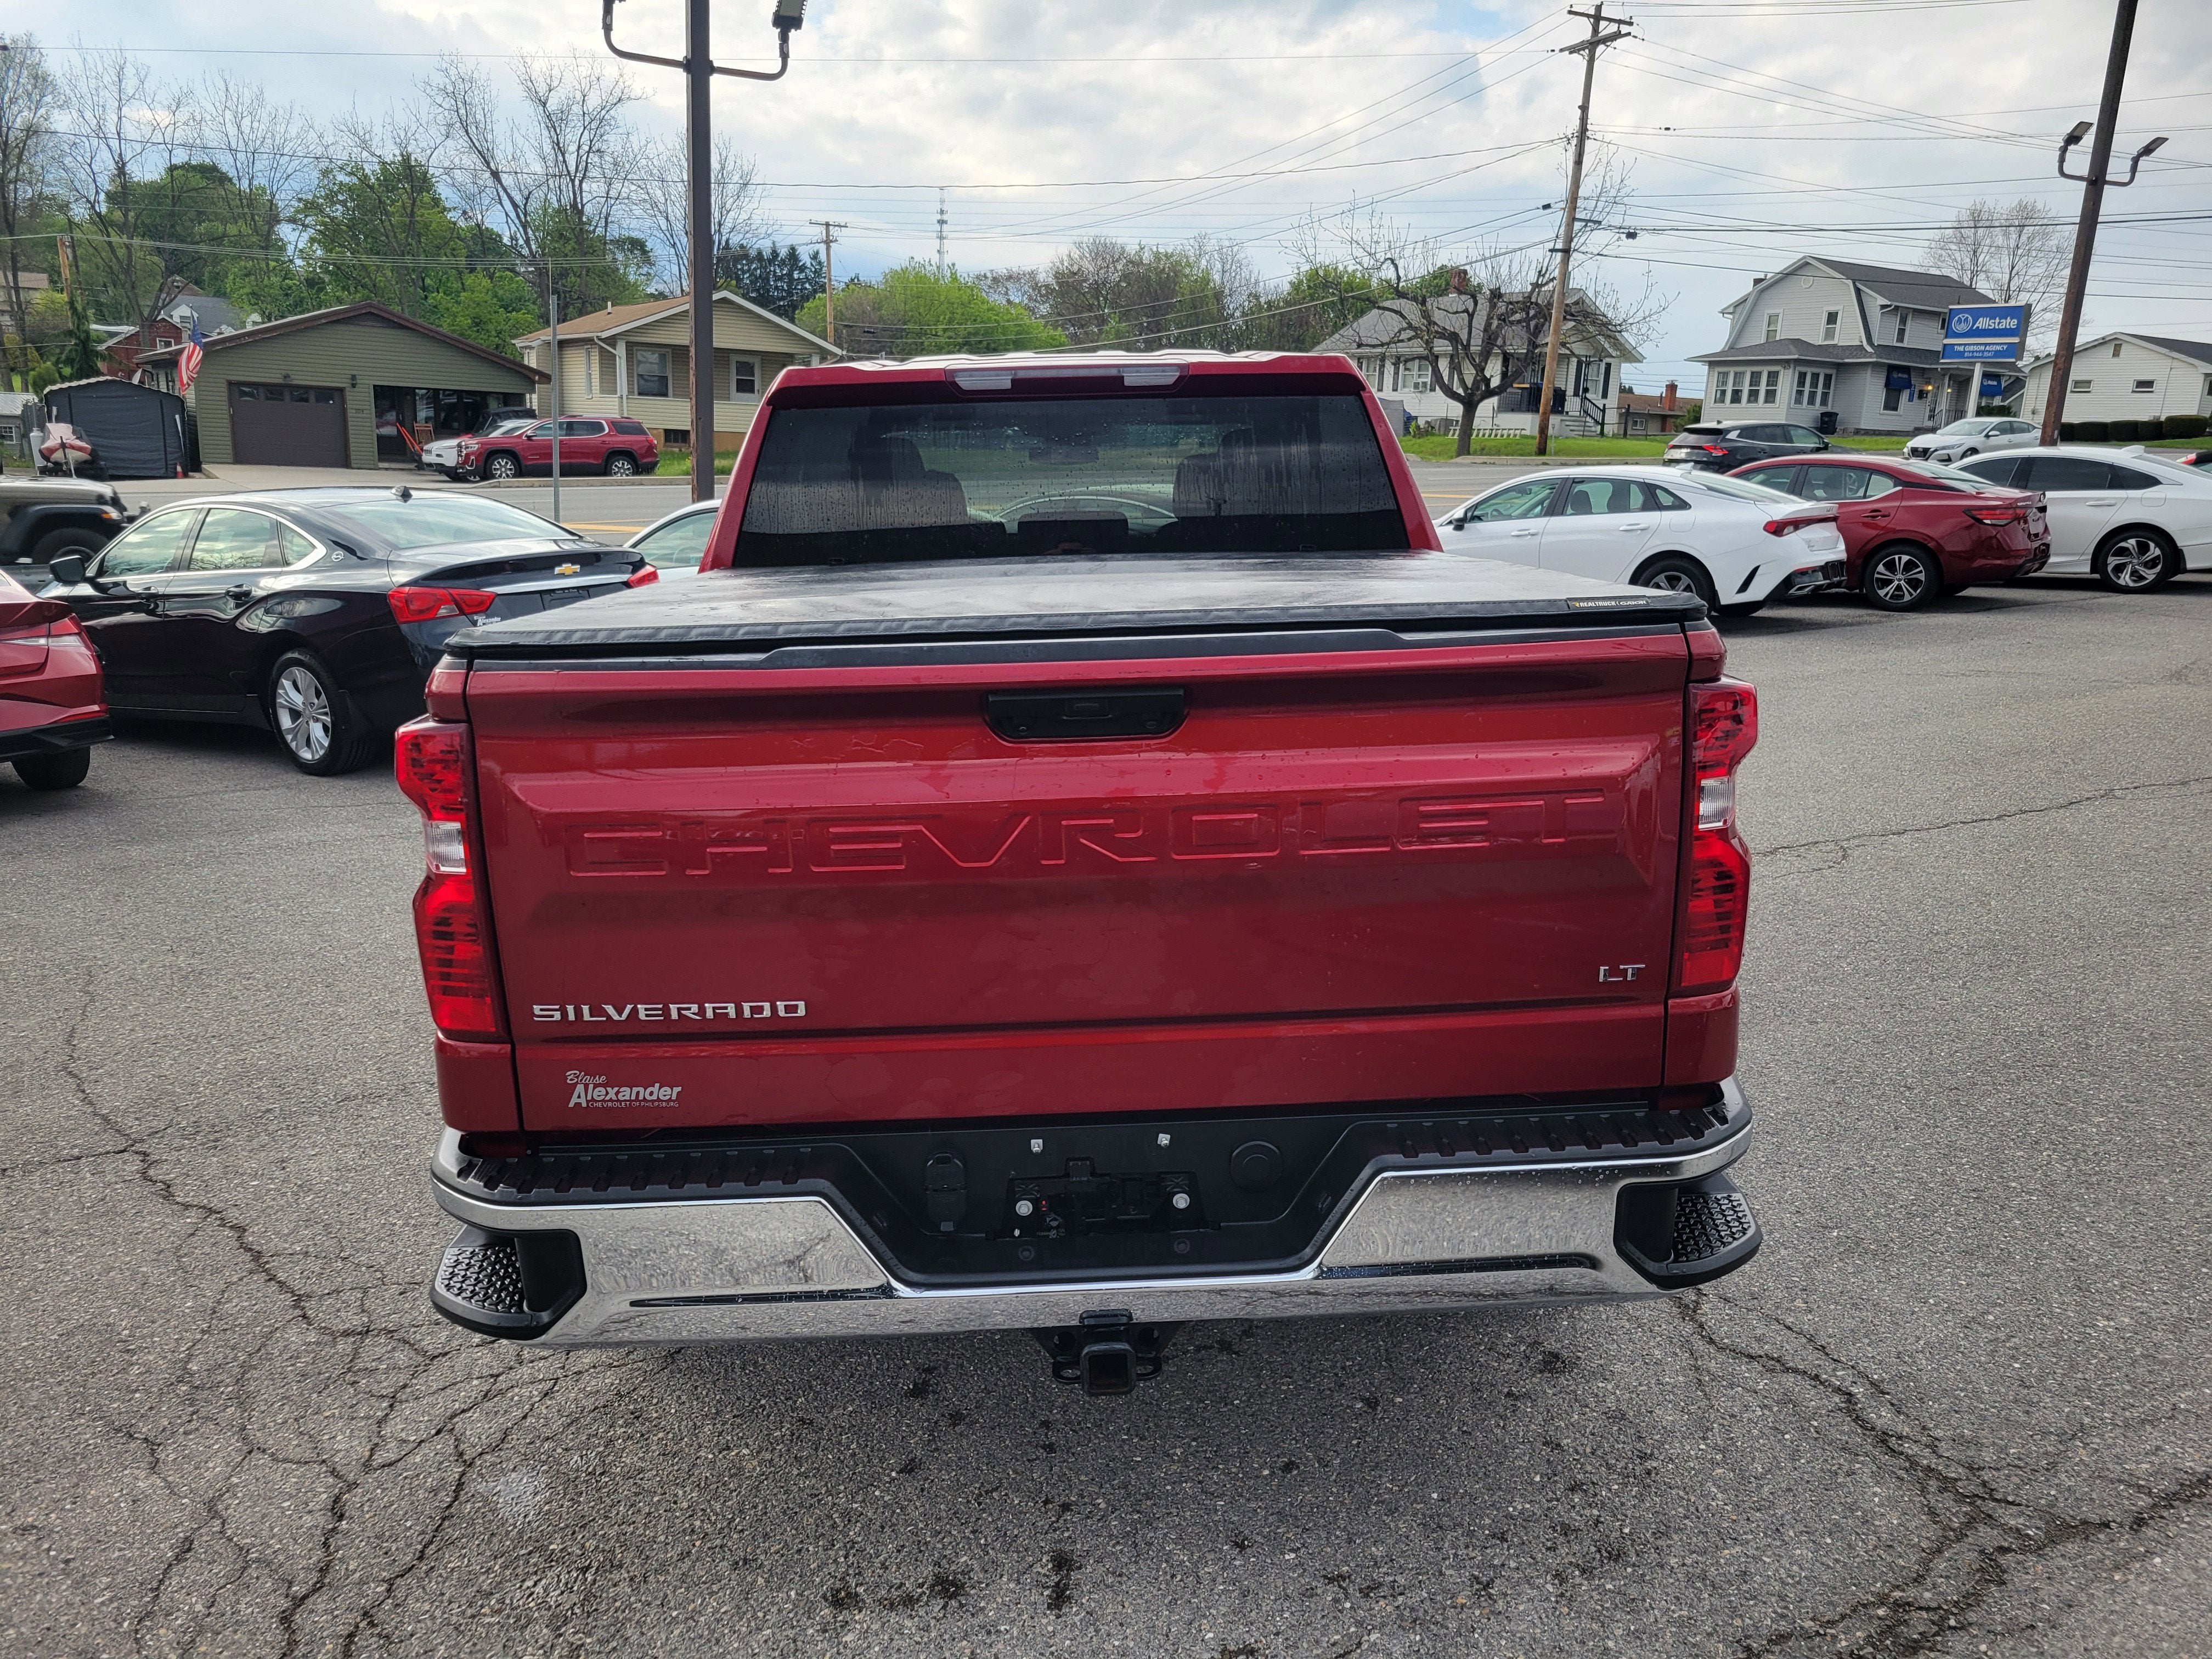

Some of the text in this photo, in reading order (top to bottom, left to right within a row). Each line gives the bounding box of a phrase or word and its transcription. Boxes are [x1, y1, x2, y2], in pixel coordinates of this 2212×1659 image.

[1973, 317, 2017, 329] Allstate
[565, 788, 1605, 877] CHEVROLET
[1599, 964, 1646, 982] LT
[532, 1001, 807, 1022] SILVERADO
[565, 1070, 607, 1084] Blaise
[568, 1083, 682, 1108] Alexander
